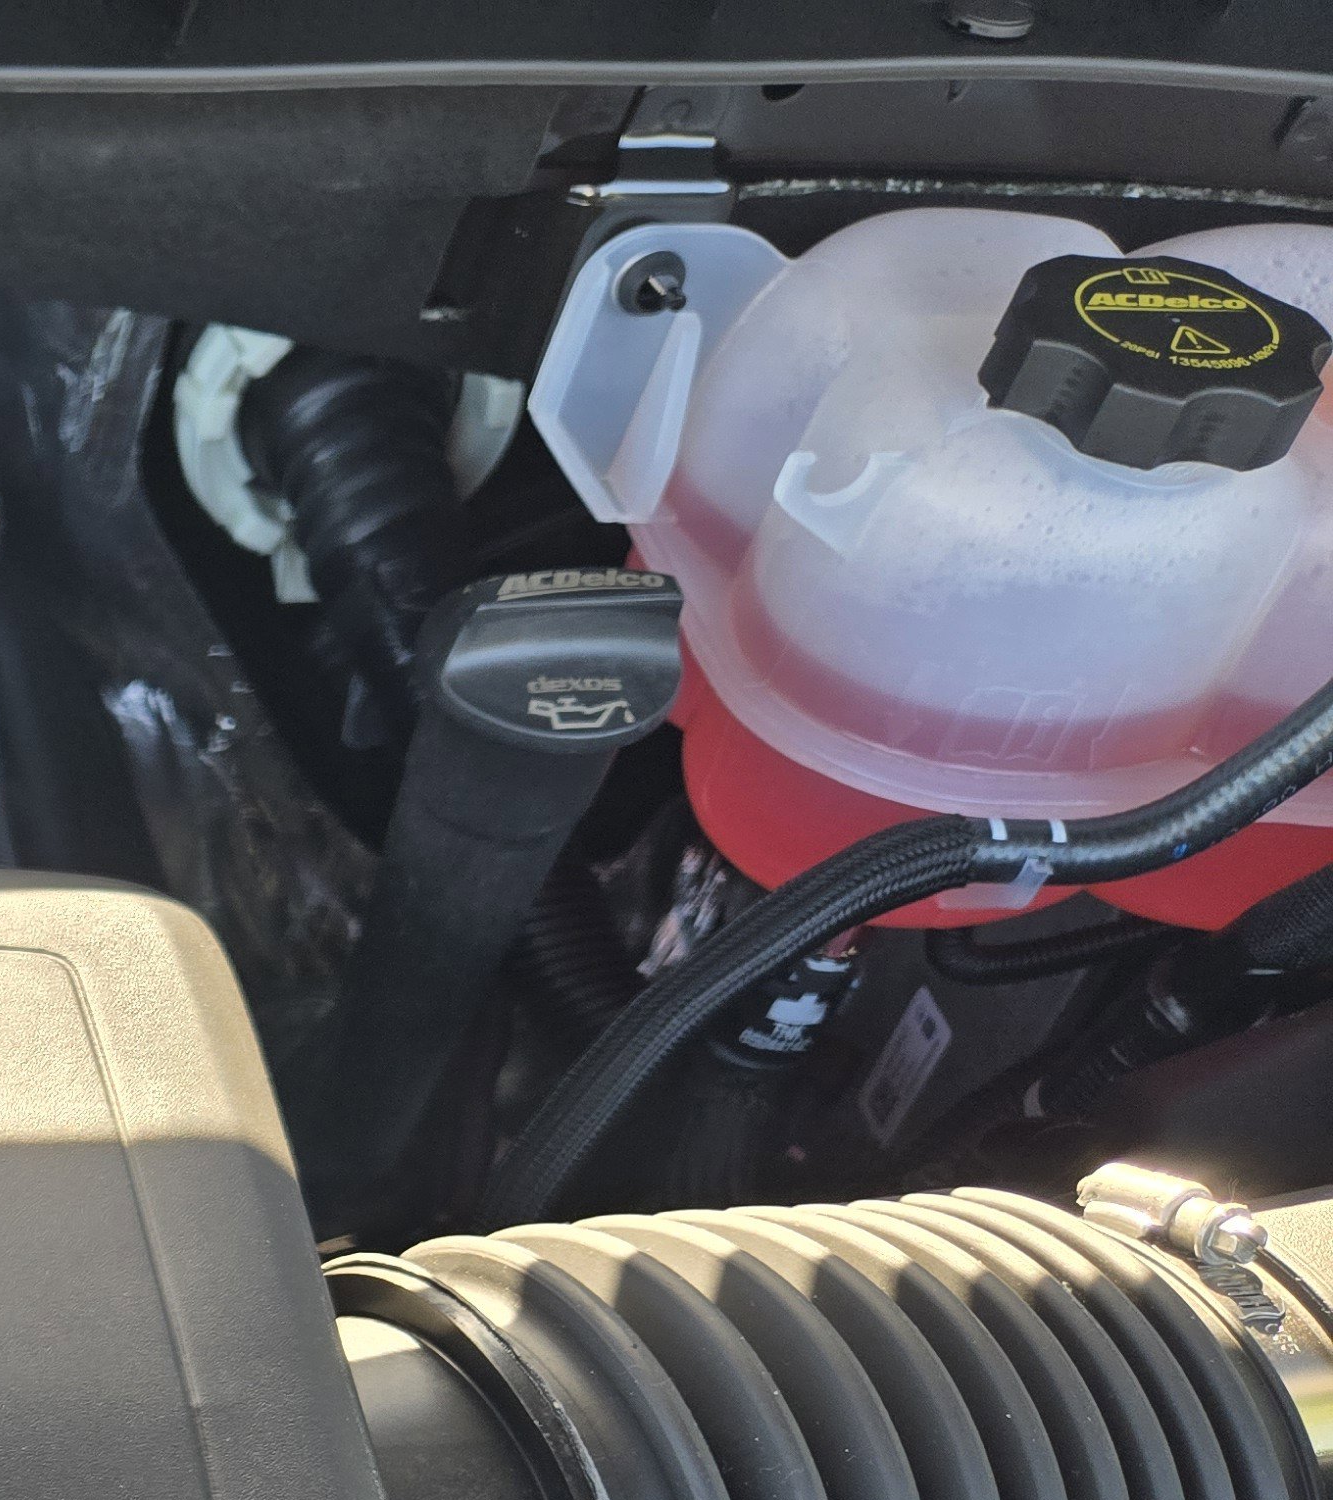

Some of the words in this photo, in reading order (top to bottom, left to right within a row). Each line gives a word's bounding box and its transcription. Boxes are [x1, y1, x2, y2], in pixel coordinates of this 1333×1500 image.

[1087, 292, 1247, 310] ACDelco
[496, 569, 665, 597] ACDelco
[527, 676, 622, 693] dexos
